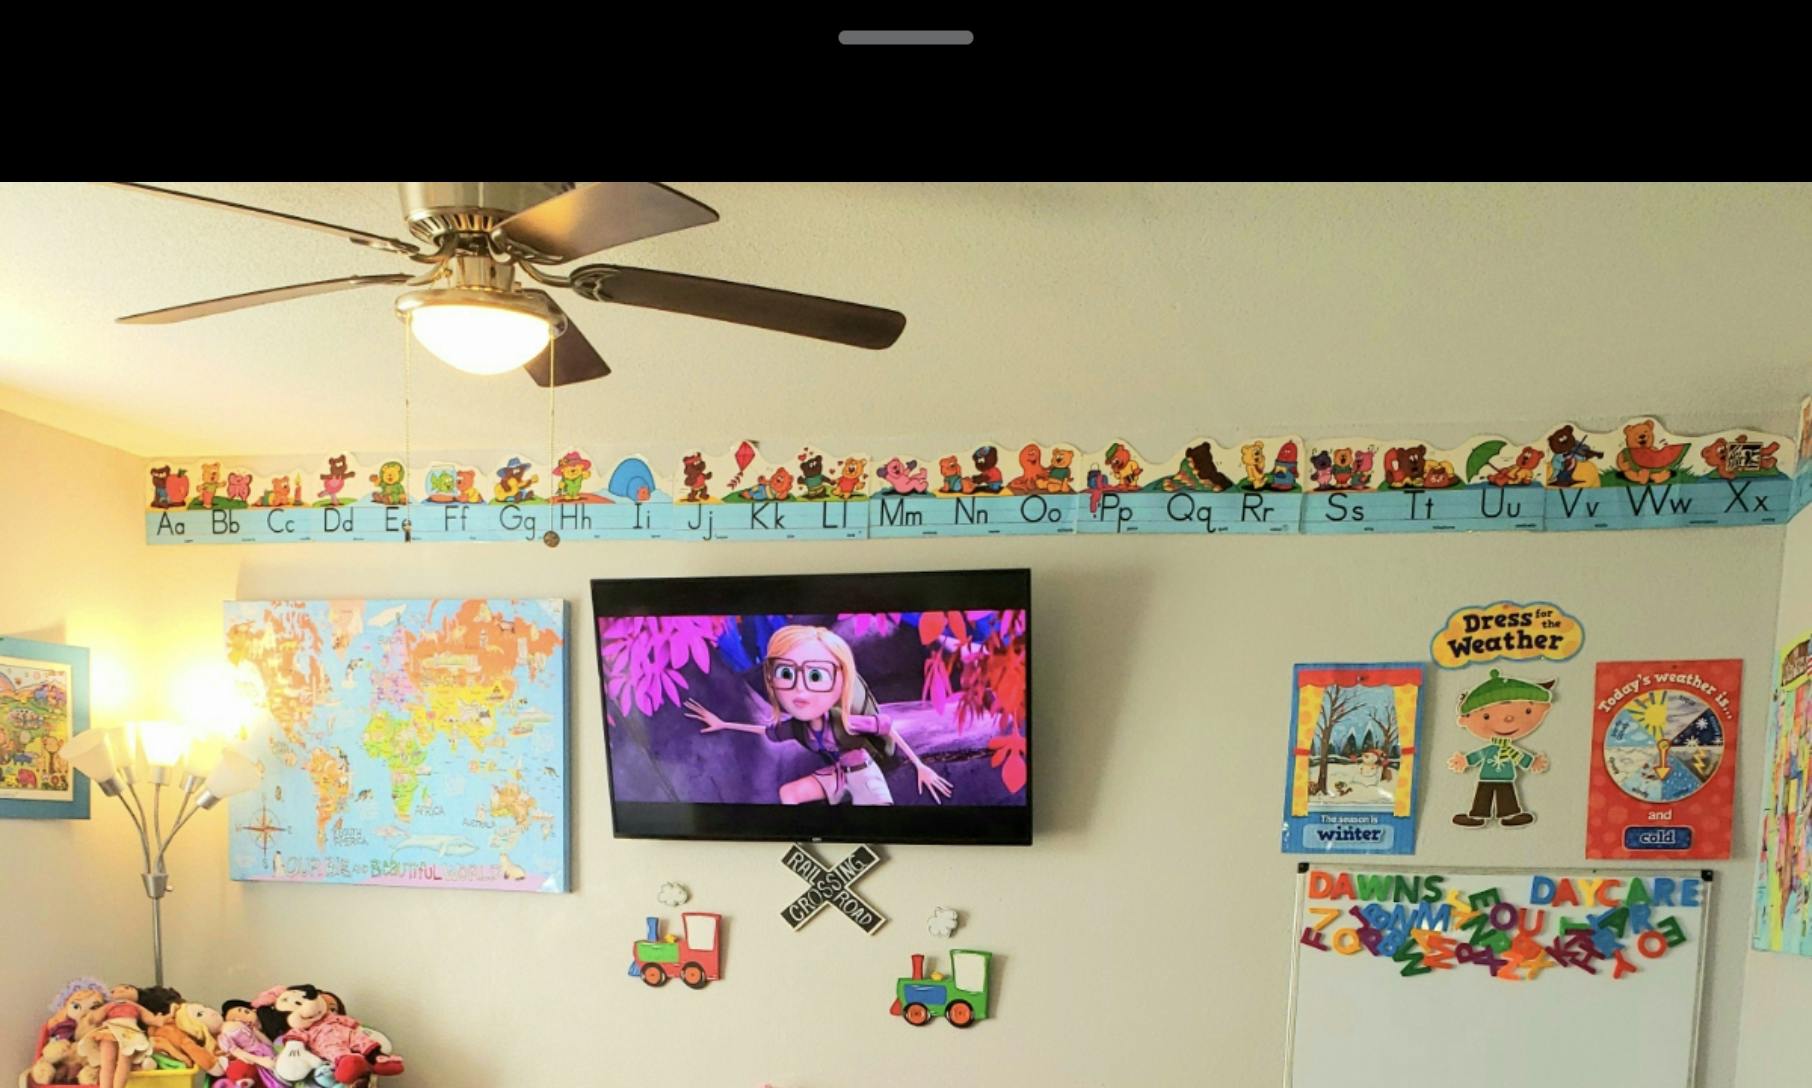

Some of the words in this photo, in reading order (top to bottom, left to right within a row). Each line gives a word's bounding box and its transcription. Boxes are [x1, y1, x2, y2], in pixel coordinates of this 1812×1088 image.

[157, 511, 185, 536] Aa
[211, 509, 240, 535] Bb
[266, 508, 295, 533] Cc
[323, 507, 353, 532] Dd
[444, 505, 470, 531] Ff
[499, 504, 536, 541] Gg
[559, 504, 592, 530] Hh
[632, 502, 651, 529] Ii
[688, 503, 713, 541] Jj
[751, 501, 786, 529] Kk
[822, 500, 847, 528] Ll
[880, 498, 922, 526] Mm
[954, 496, 988, 525] Nn
[1020, 494, 1062, 523] Oo
[1100, 493, 1133, 533] Pp
[1166, 492, 1216, 533] Qq
[1241, 492, 1274, 522] Rr
[1325, 492, 1364, 521] Ss
[1403, 489, 1434, 520] Tt
[1480, 488, 1521, 518] Uu
[1559, 487, 1600, 518] Vv
[1626, 484, 1693, 516] Ww
[1724, 481, 1768, 513] Xx
[1463, 612, 1533, 633] Dress
[1535, 608, 1553, 618] for
[1541, 619, 1561, 629] the
[1447, 630, 1564, 658] Weather
[1598, 674, 1651, 712] Today's
[1654, 672, 1717, 695] weather
[1647, 810, 1672, 821] and
[1316, 826, 1382, 841] winter
[1639, 829, 1676, 844] cold
[789, 854, 868, 922] CROSSING
[1308, 871, 1445, 904] DAWNS
[1530, 875, 1700, 907] DAYCARE
